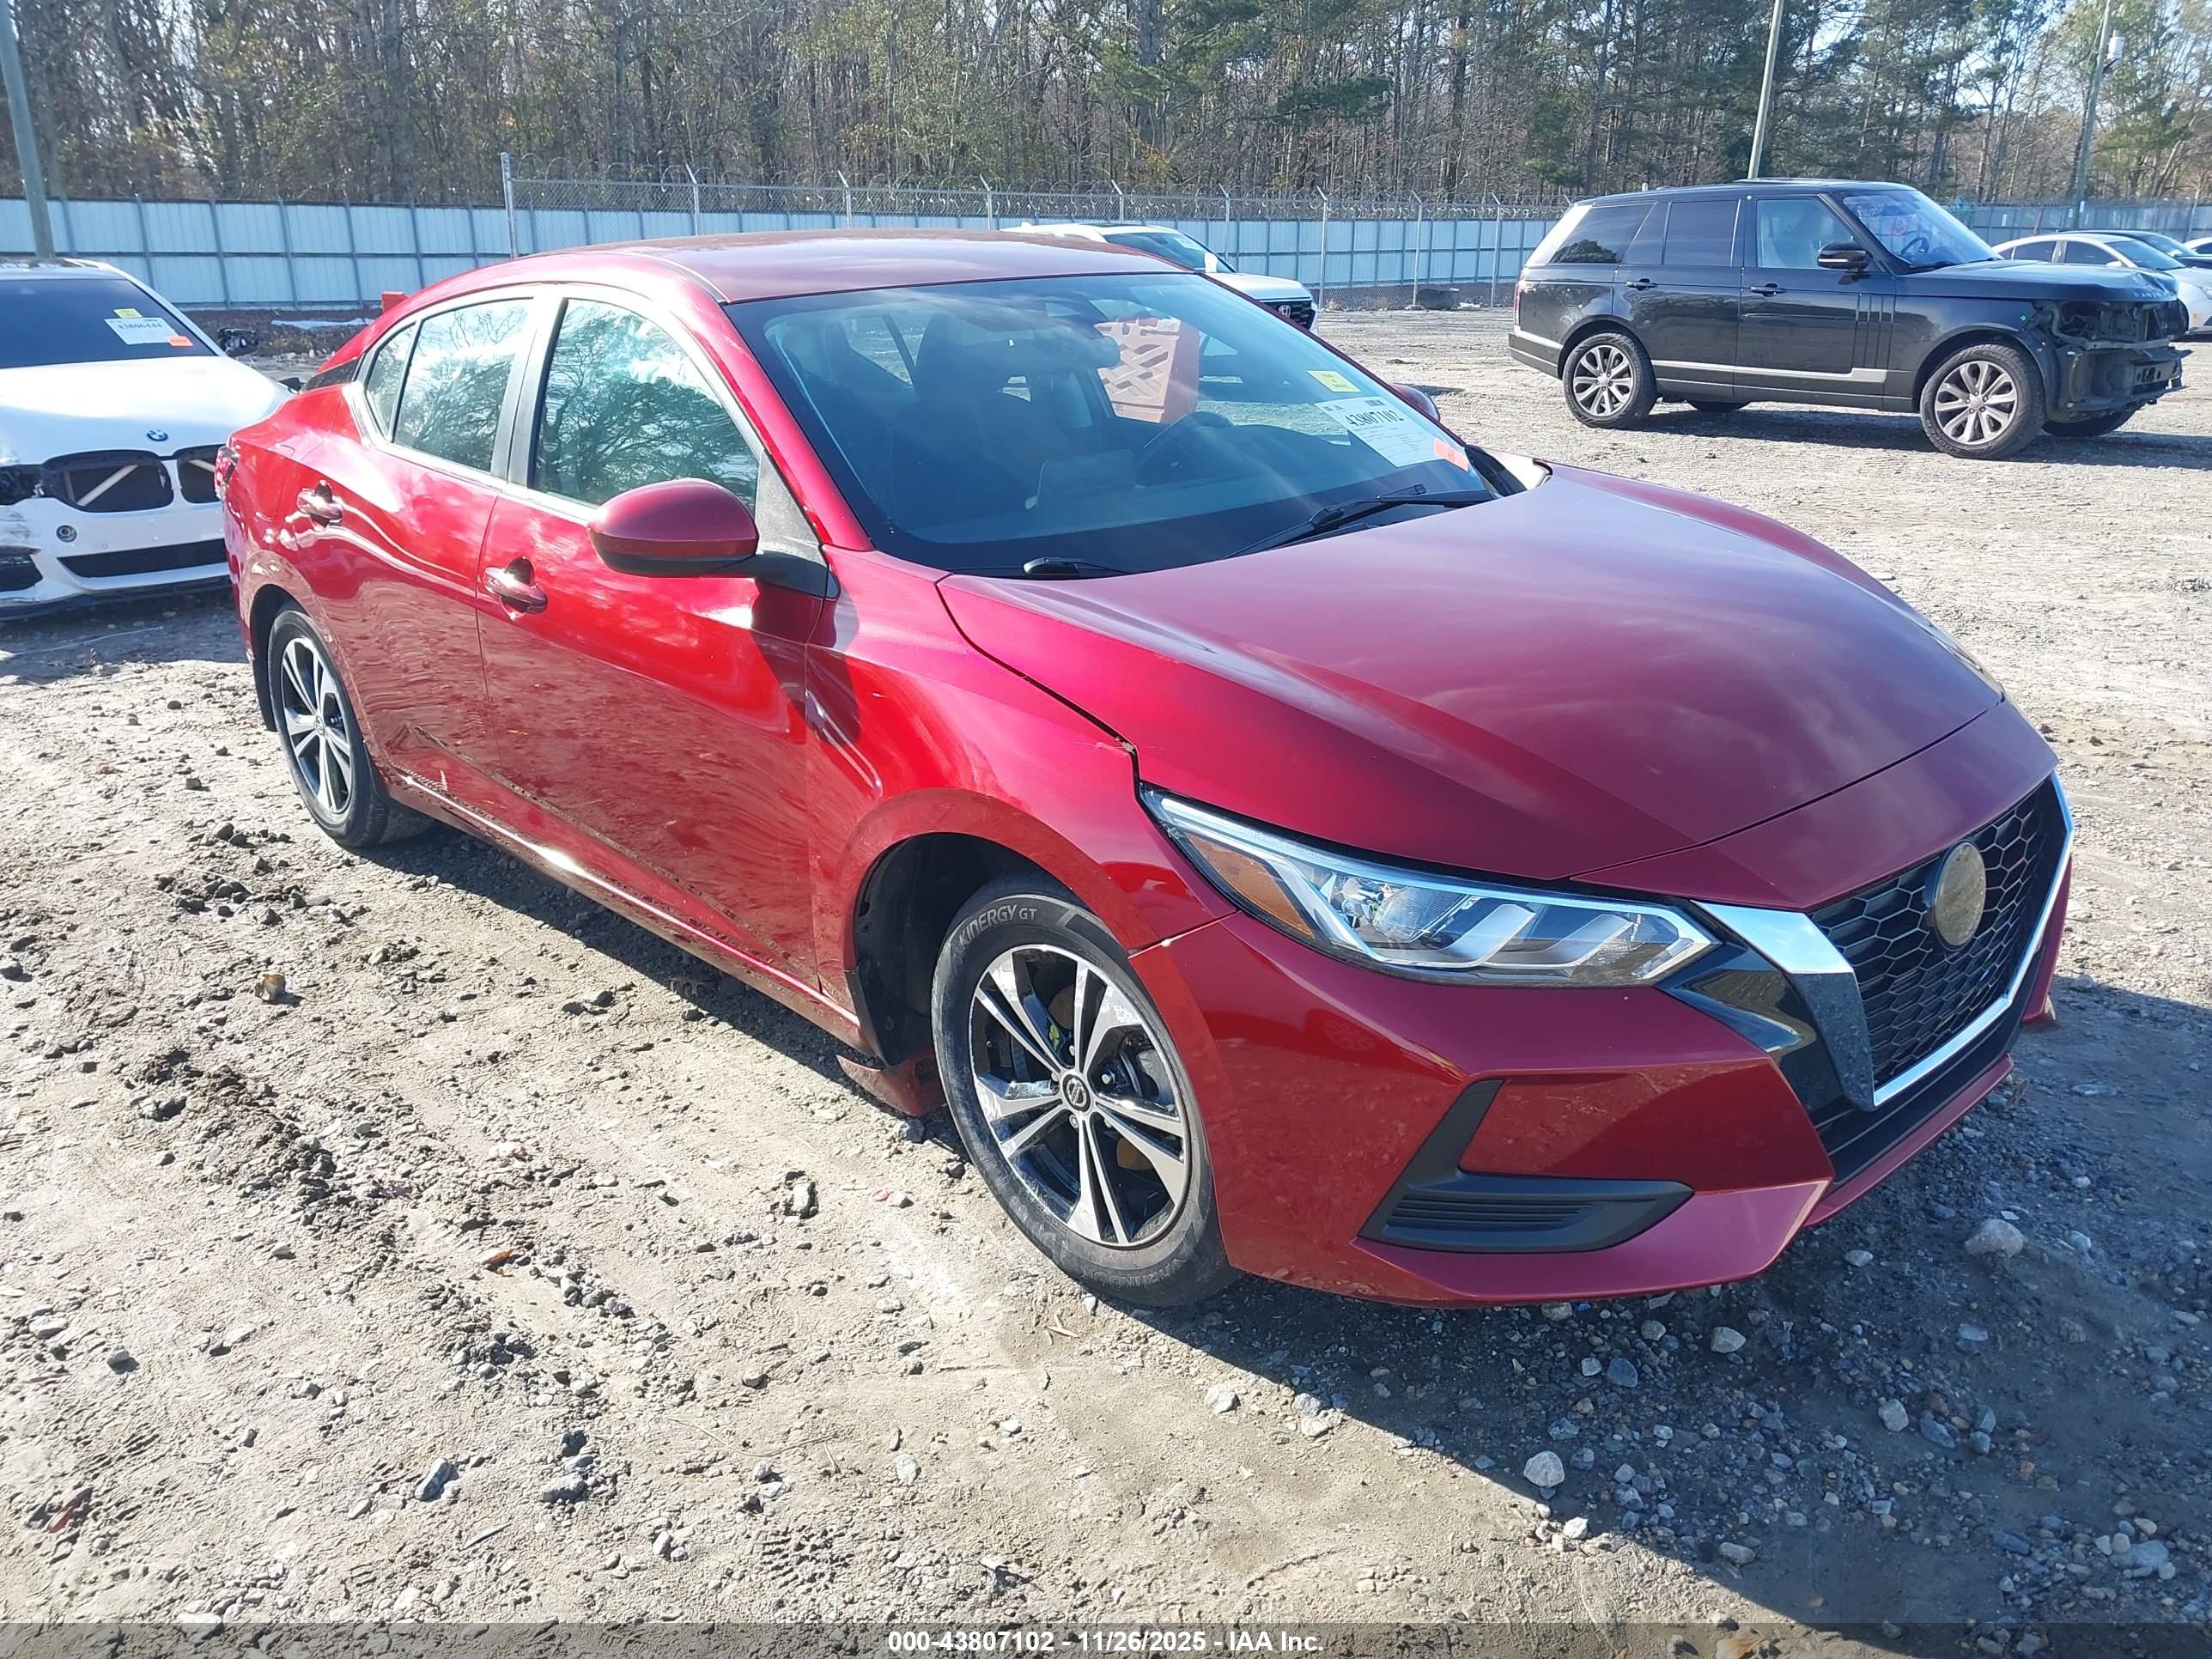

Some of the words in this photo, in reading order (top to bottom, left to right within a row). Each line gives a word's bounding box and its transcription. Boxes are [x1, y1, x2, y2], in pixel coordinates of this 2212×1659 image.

[1345, 409, 1405, 427] 43807102
[958, 904, 1018, 951] KINERGY
[1018, 908, 1037, 921] GT
